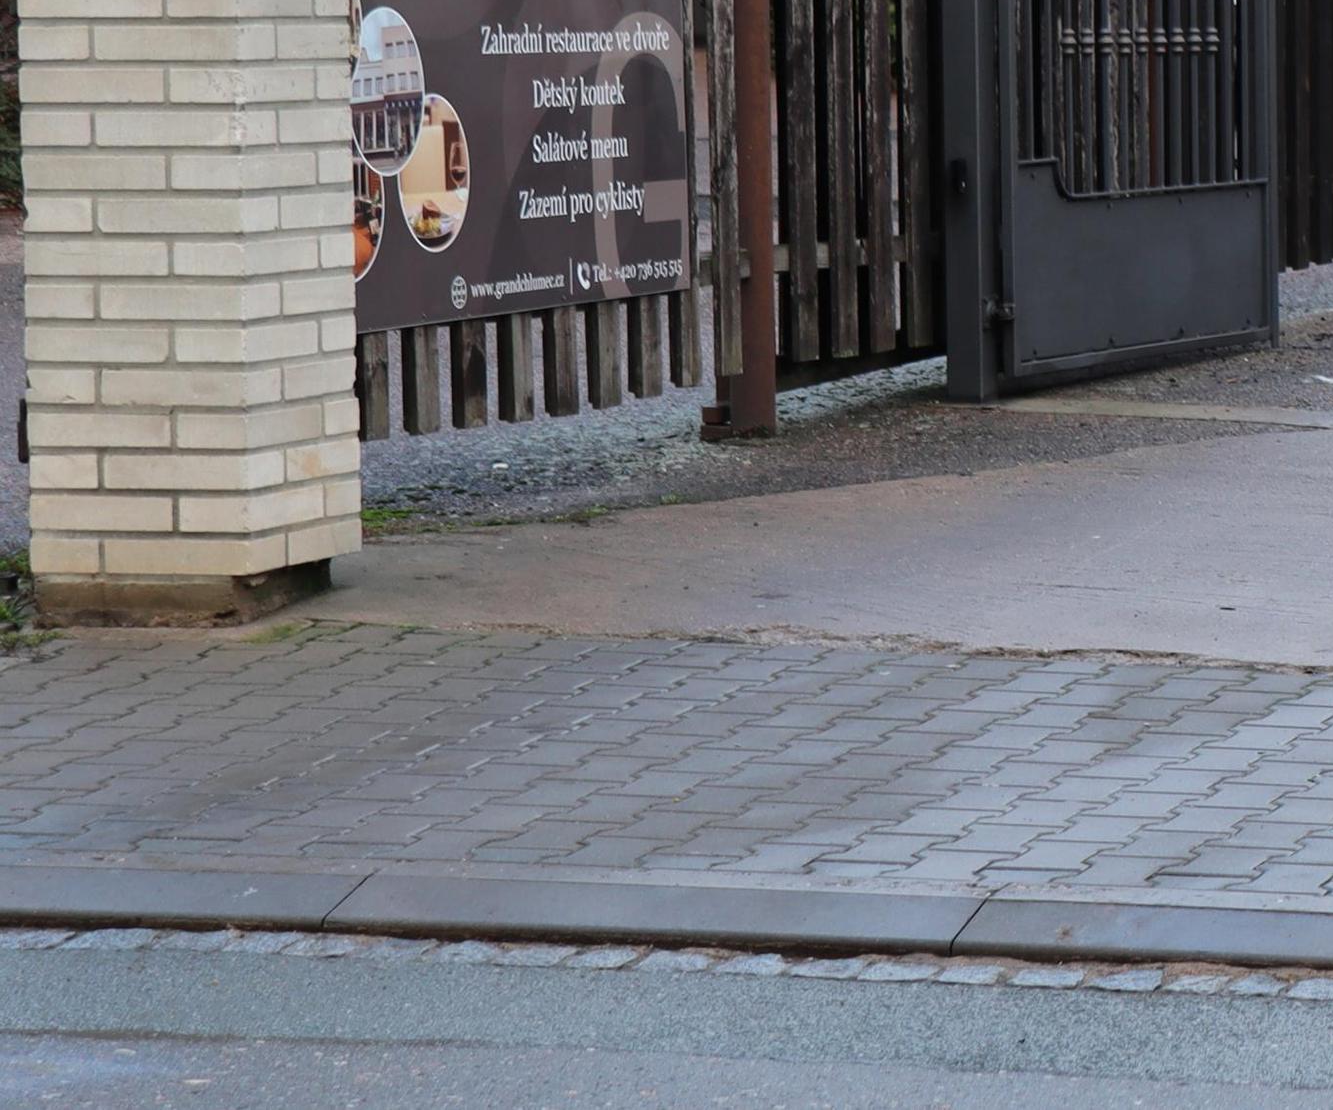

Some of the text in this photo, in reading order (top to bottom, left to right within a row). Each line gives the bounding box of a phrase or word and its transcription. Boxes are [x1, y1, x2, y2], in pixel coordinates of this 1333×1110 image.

[480, 22, 670, 54] Zahradní restaurace ve dvoře
[532, 75, 625, 114] Dětský koutek
[532, 130, 628, 163] Salátové menu
[519, 181, 645, 223] Zázemí pro cyklisty
[654, 261, 668, 279] 515
[669, 259, 683, 277] 515
